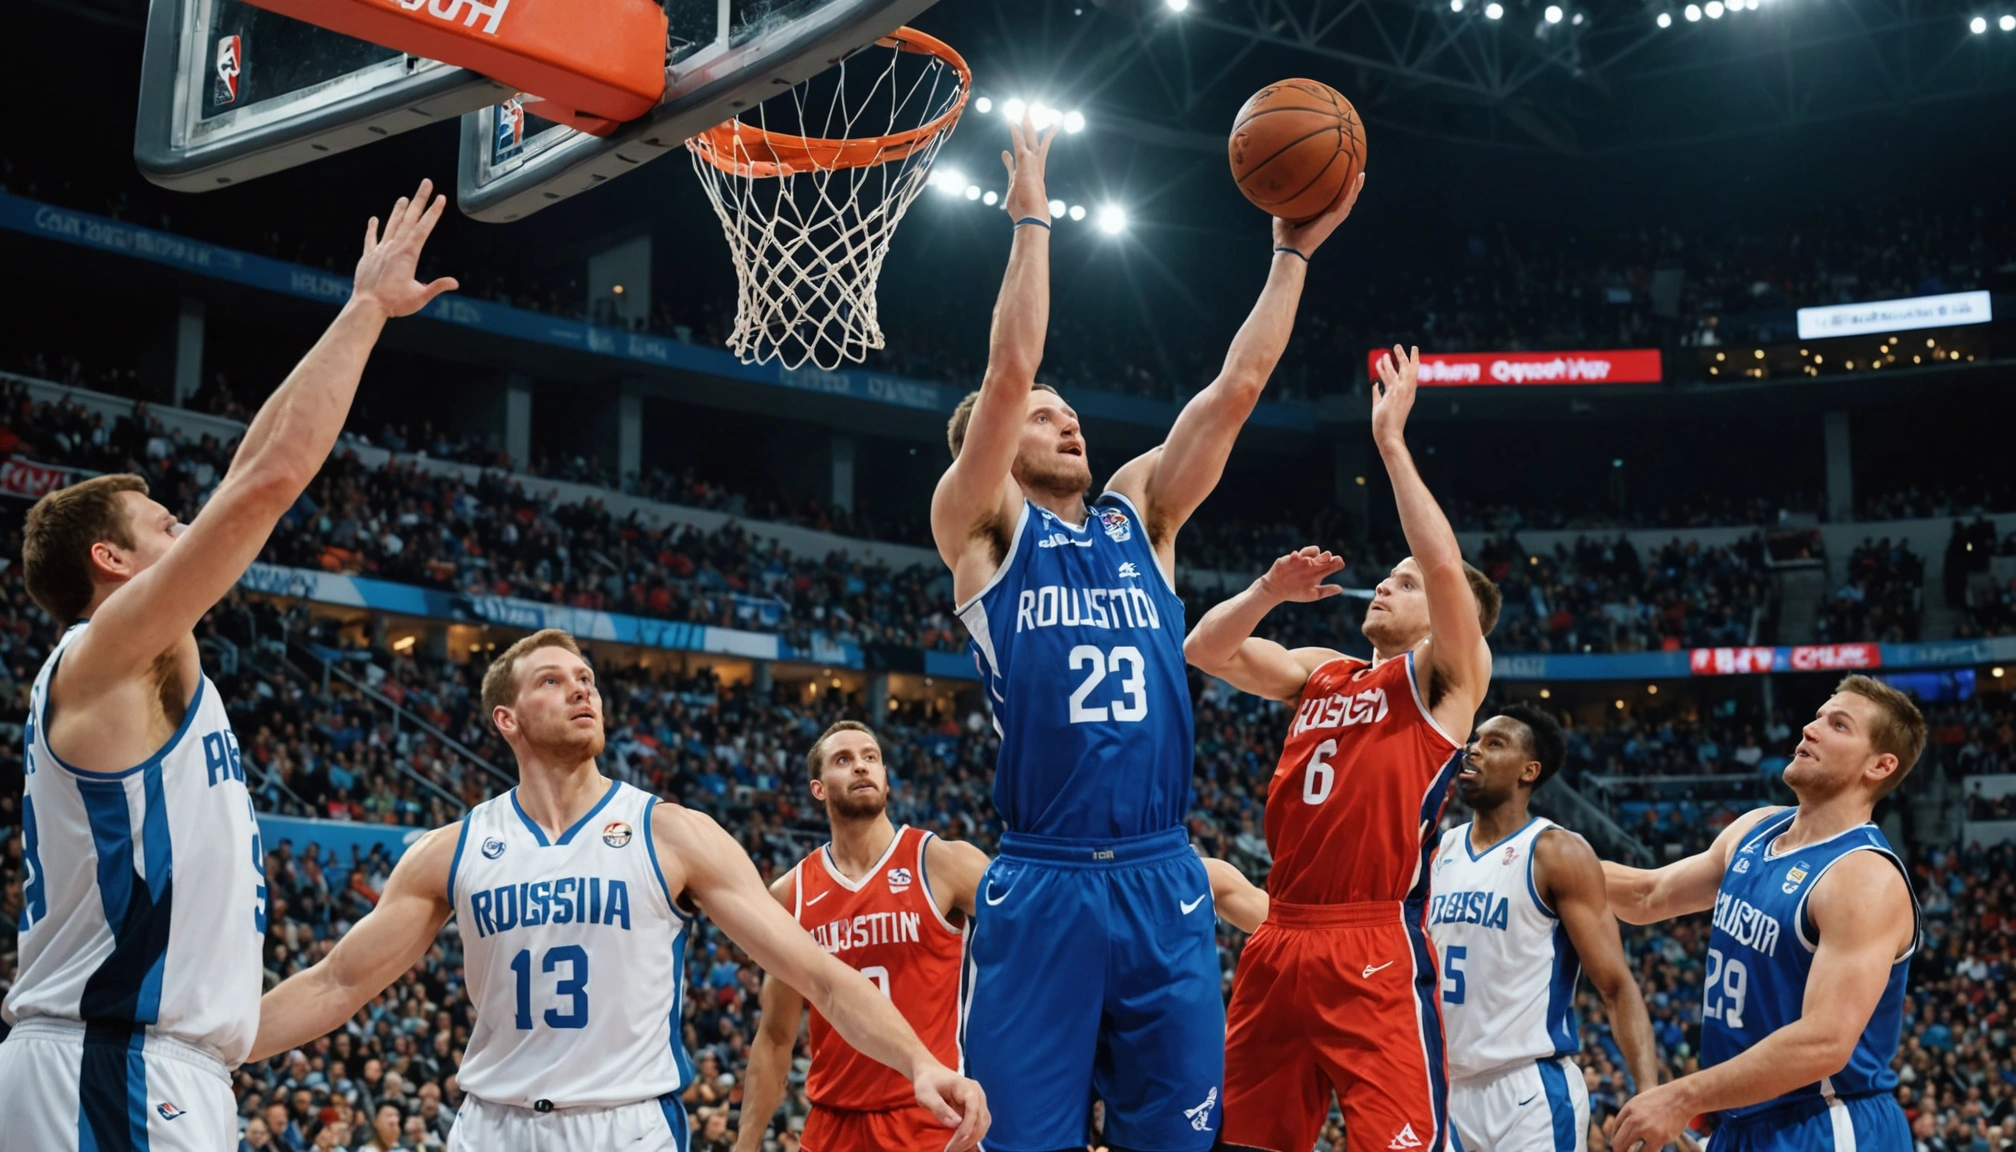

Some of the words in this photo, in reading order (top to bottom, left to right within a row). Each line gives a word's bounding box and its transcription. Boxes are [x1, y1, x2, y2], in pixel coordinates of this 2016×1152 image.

[1068, 644, 1148, 724] 23
[1302, 738, 1338, 805] 6
[510, 944, 588, 1030] 13
[1702, 948, 1748, 1028] 29
